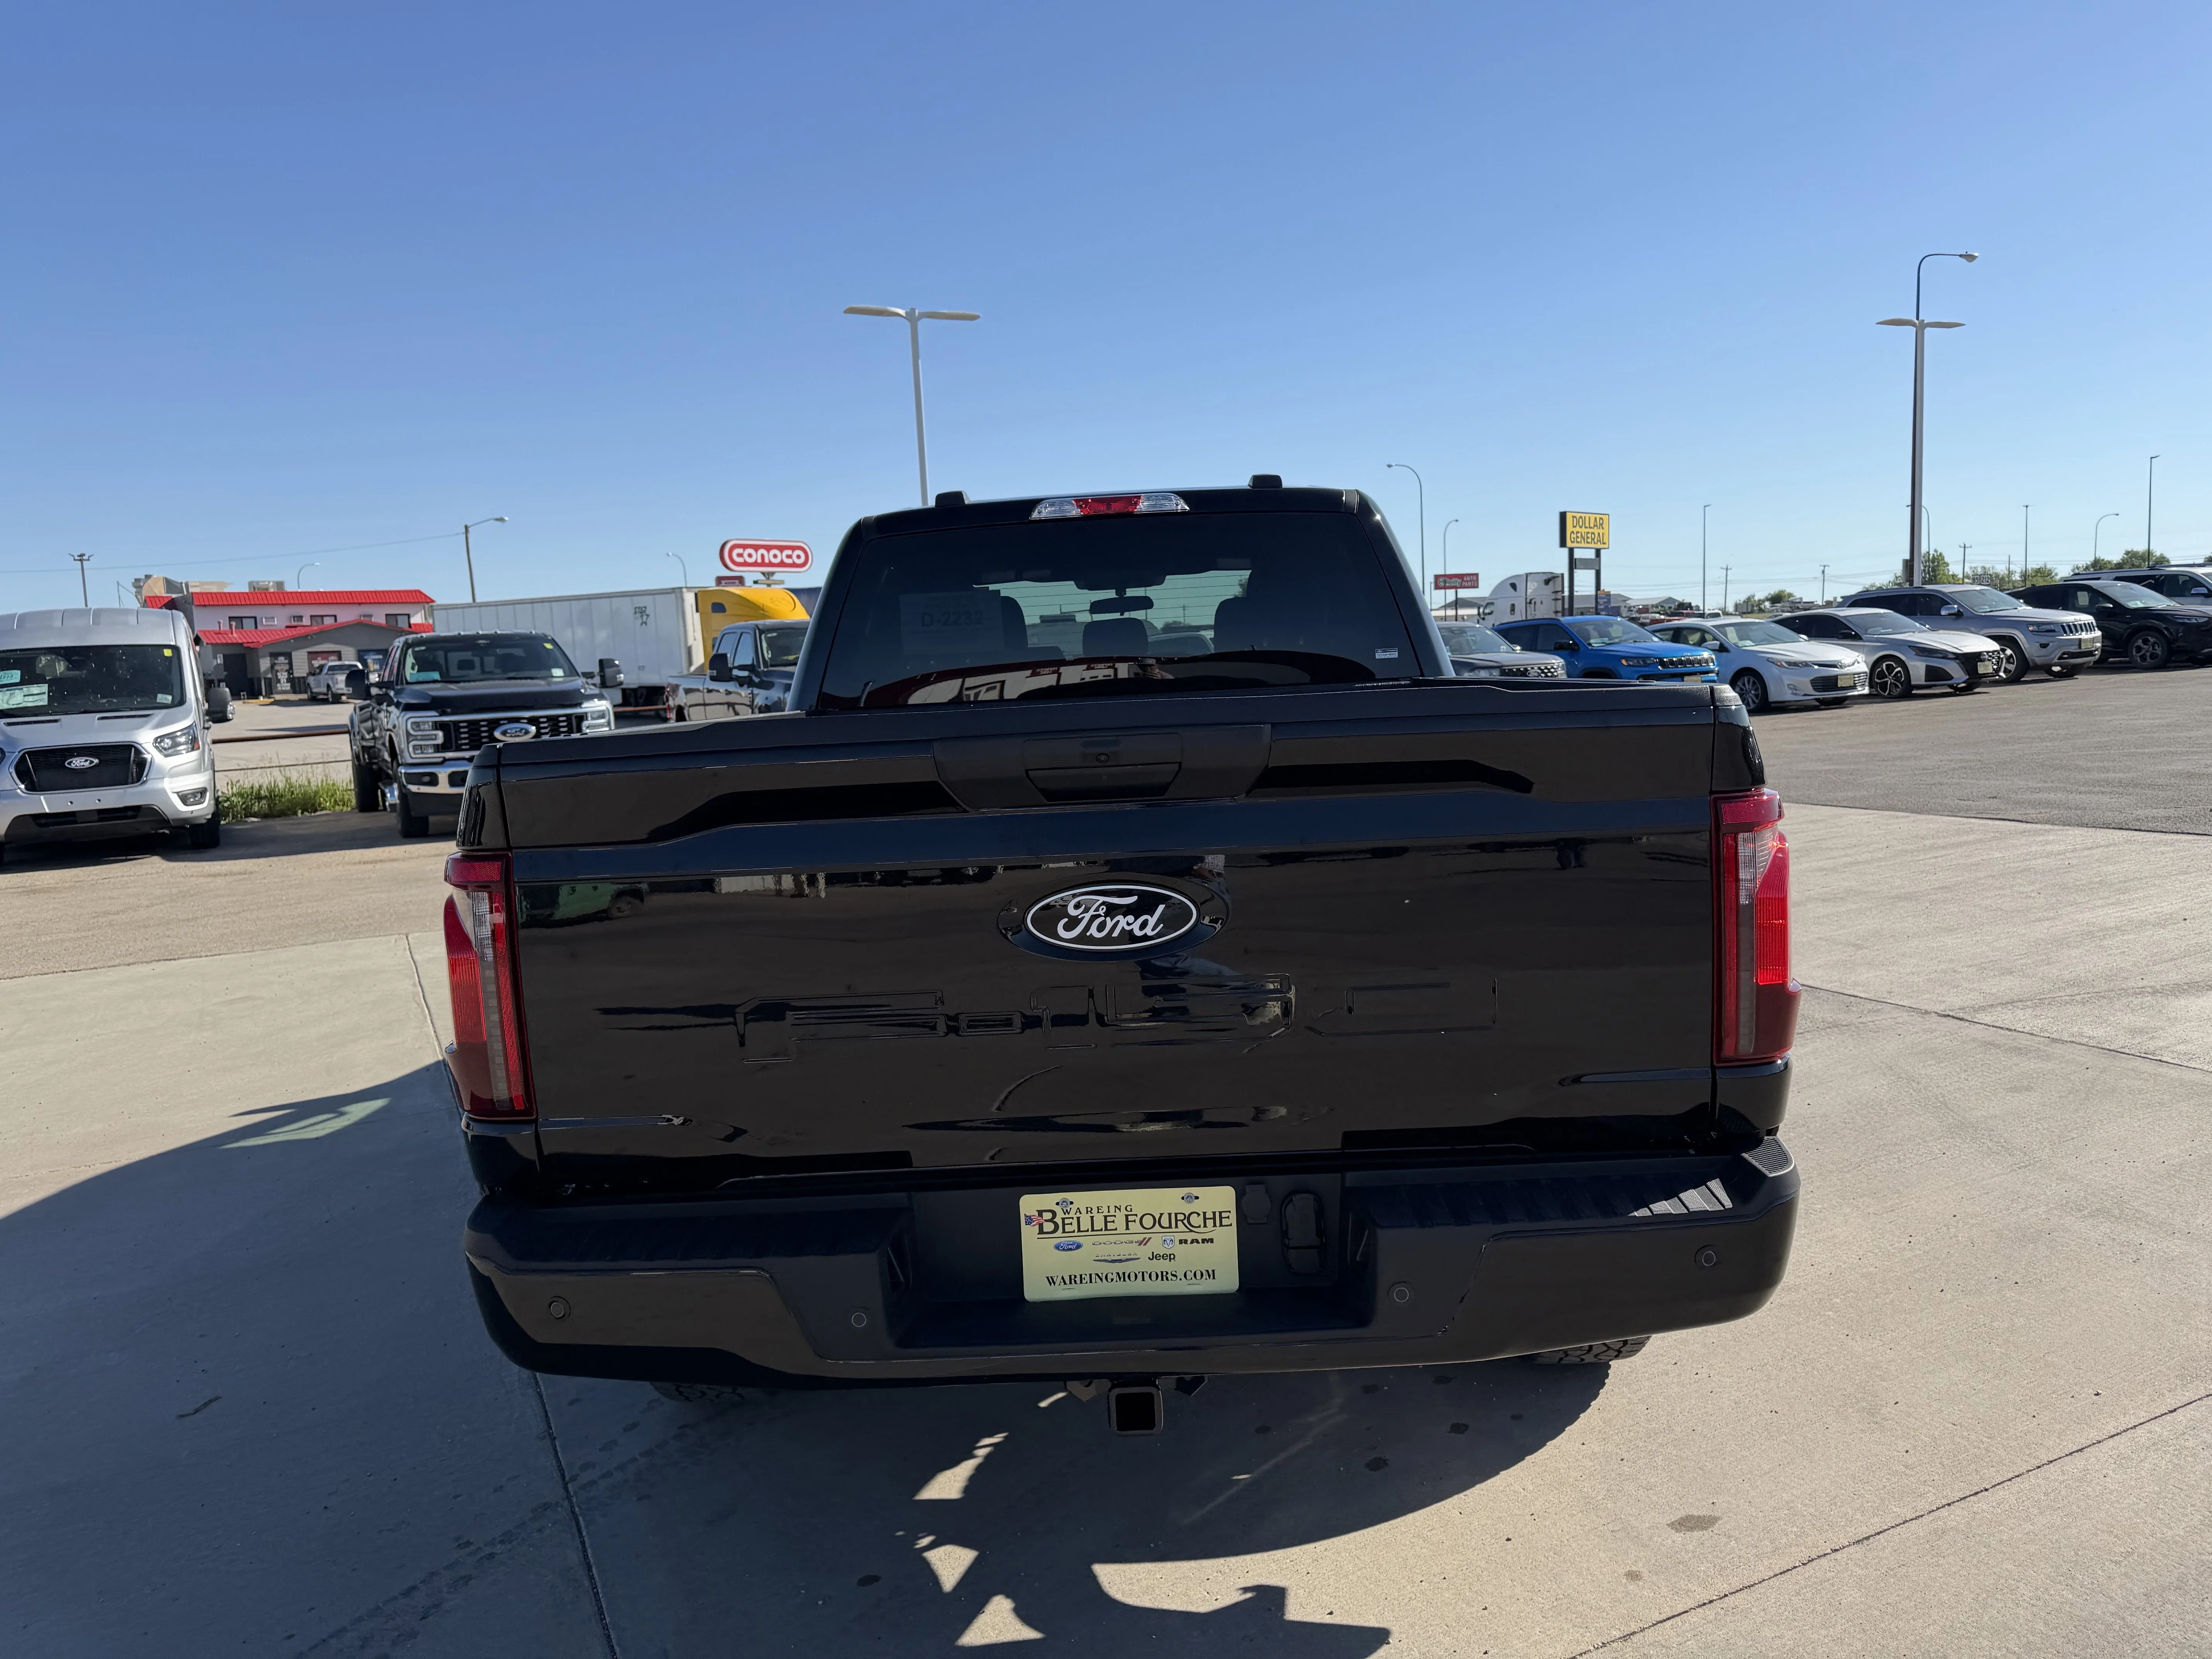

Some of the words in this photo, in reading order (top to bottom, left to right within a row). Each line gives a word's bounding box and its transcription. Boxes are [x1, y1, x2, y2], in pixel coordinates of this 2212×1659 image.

[1571, 515, 1604, 530] DOLLAR
[1570, 531, 1606, 545] GENERAL
[71, 759, 90, 767] Ford
[1057, 895, 1166, 939] Ford
[1061, 1205, 1133, 1215] WAREING
[1036, 1209, 1117, 1235] BELLE
[1124, 1210, 1232, 1233] FOURCHE
[1148, 1251, 1176, 1262] Jeep
[1045, 1269, 1216, 1286] WAREINGMOTORS.COM
